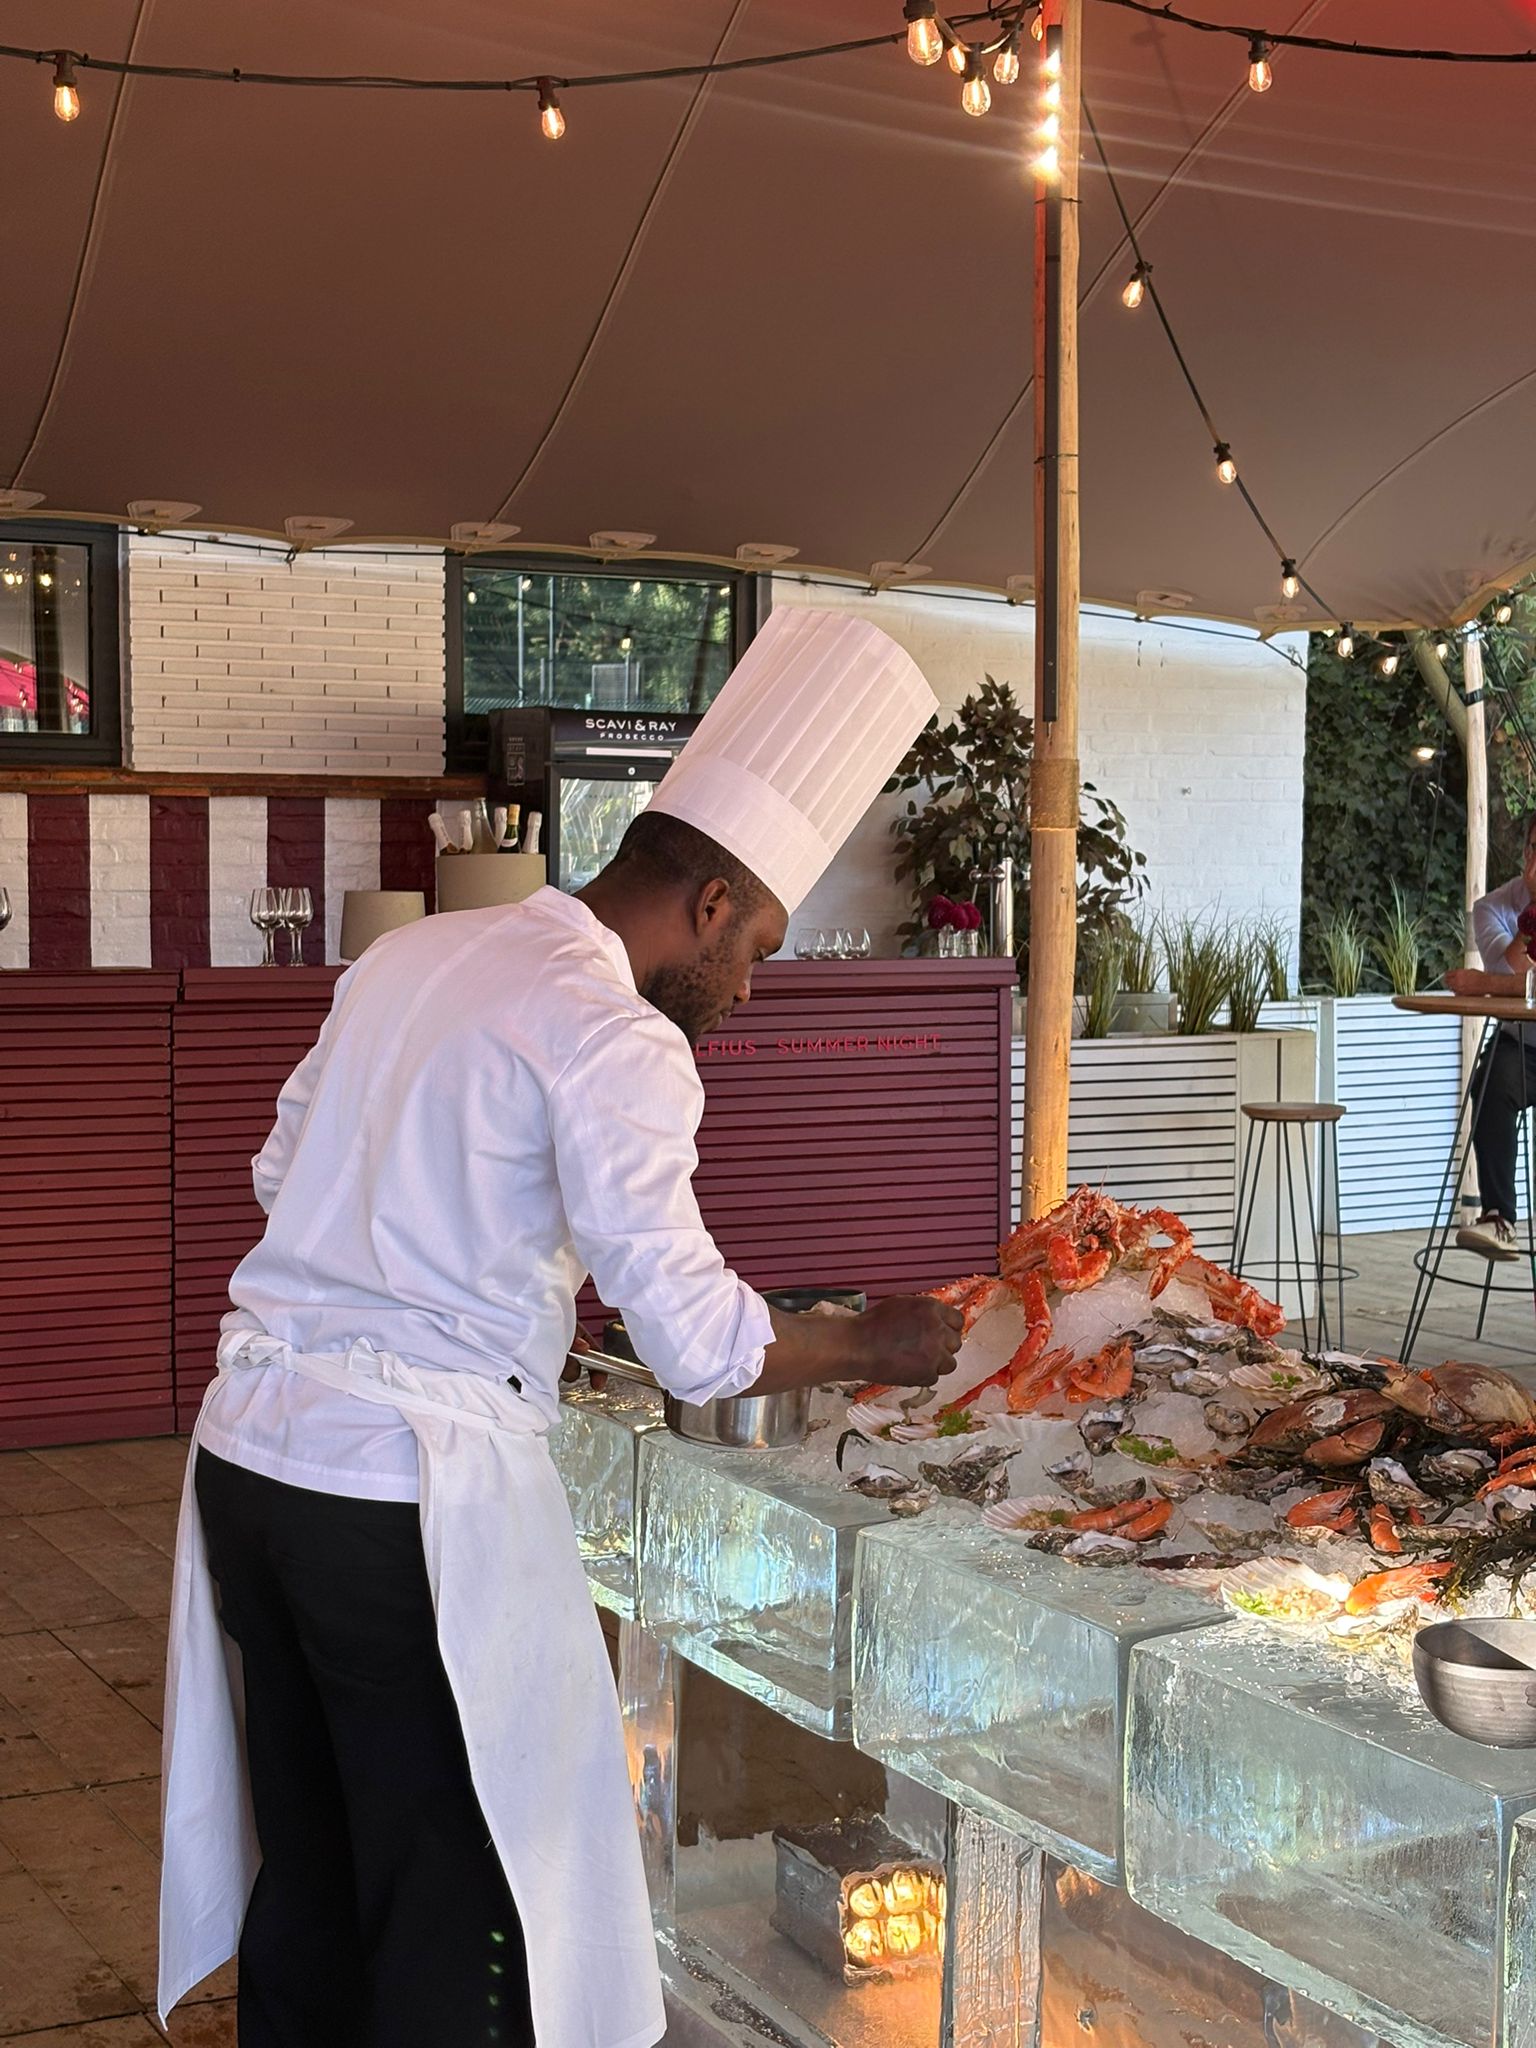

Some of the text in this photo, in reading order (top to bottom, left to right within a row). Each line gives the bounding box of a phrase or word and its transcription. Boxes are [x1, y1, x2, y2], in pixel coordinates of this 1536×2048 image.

[599, 732, 664, 741] PROSECCO
[695, 1033, 942, 1057] LFIUS SUMMER NIGHT
